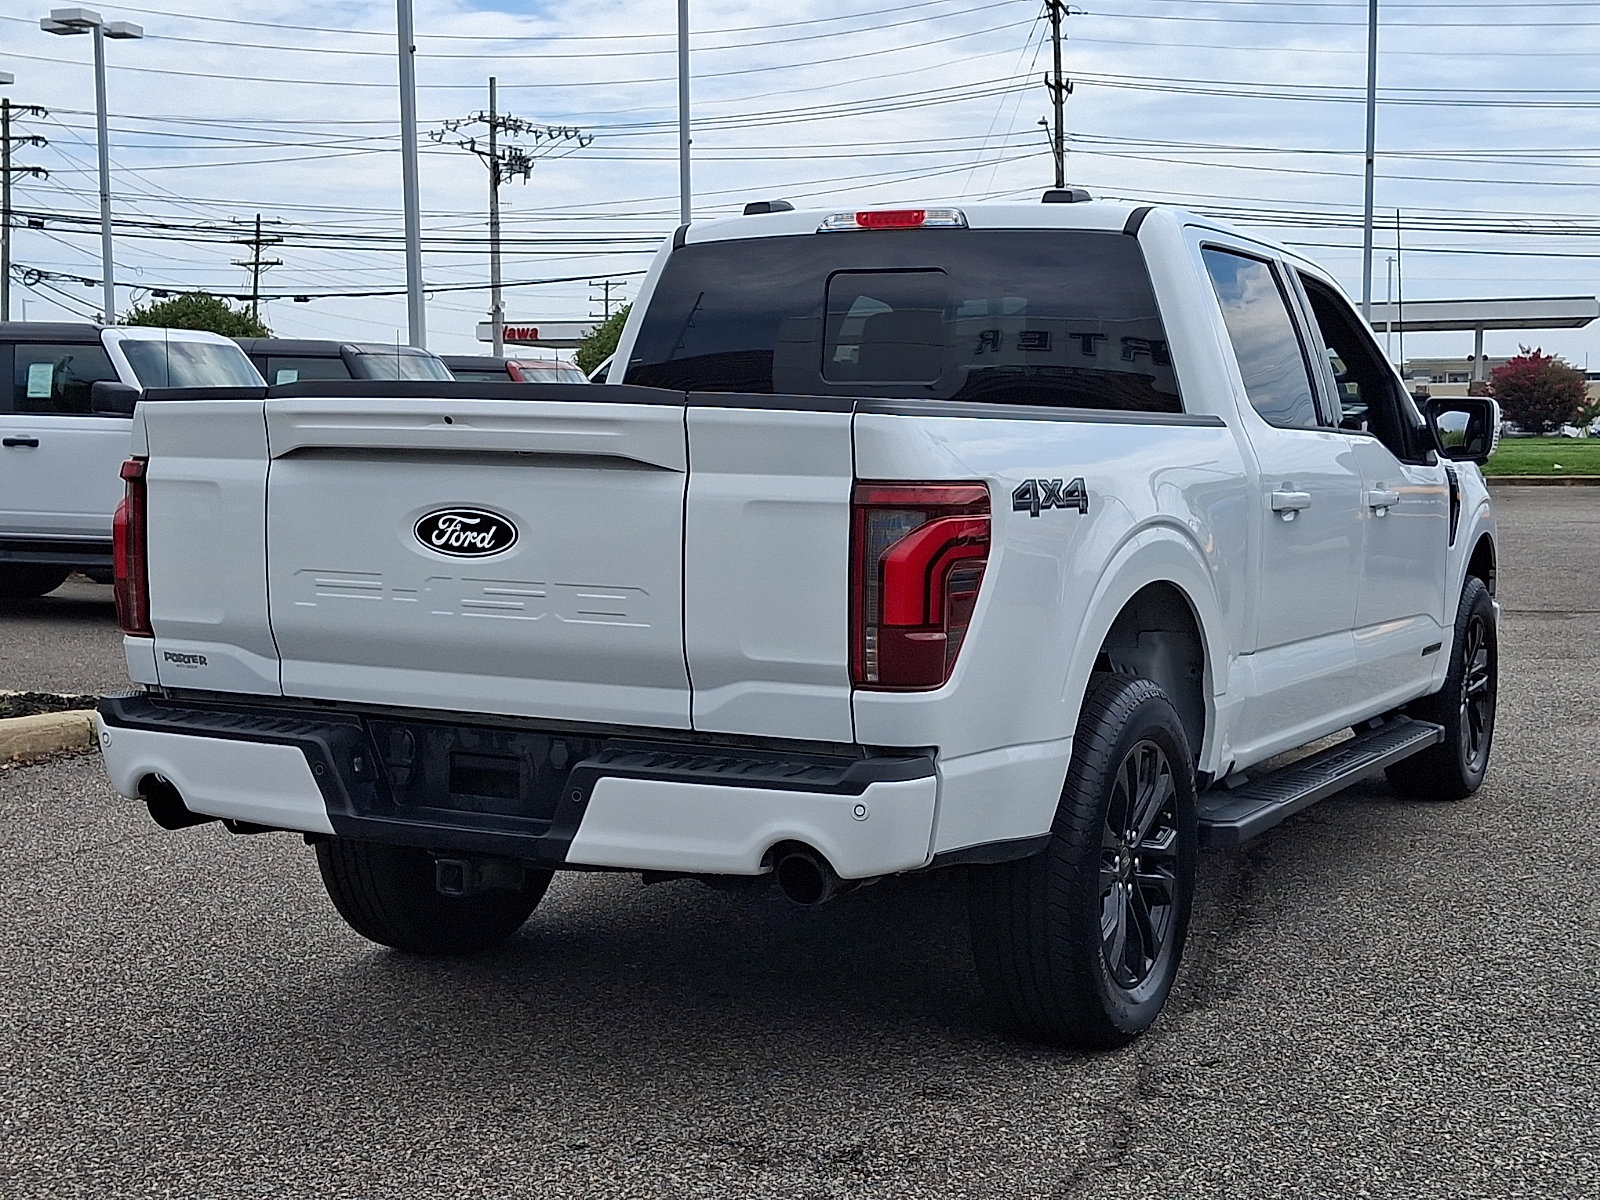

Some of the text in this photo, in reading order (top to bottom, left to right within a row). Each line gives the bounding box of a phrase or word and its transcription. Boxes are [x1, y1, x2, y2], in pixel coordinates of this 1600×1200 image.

[502, 325, 539, 341] awa
[431, 514, 498, 549] Ford
[163, 651, 208, 666] PORTER
